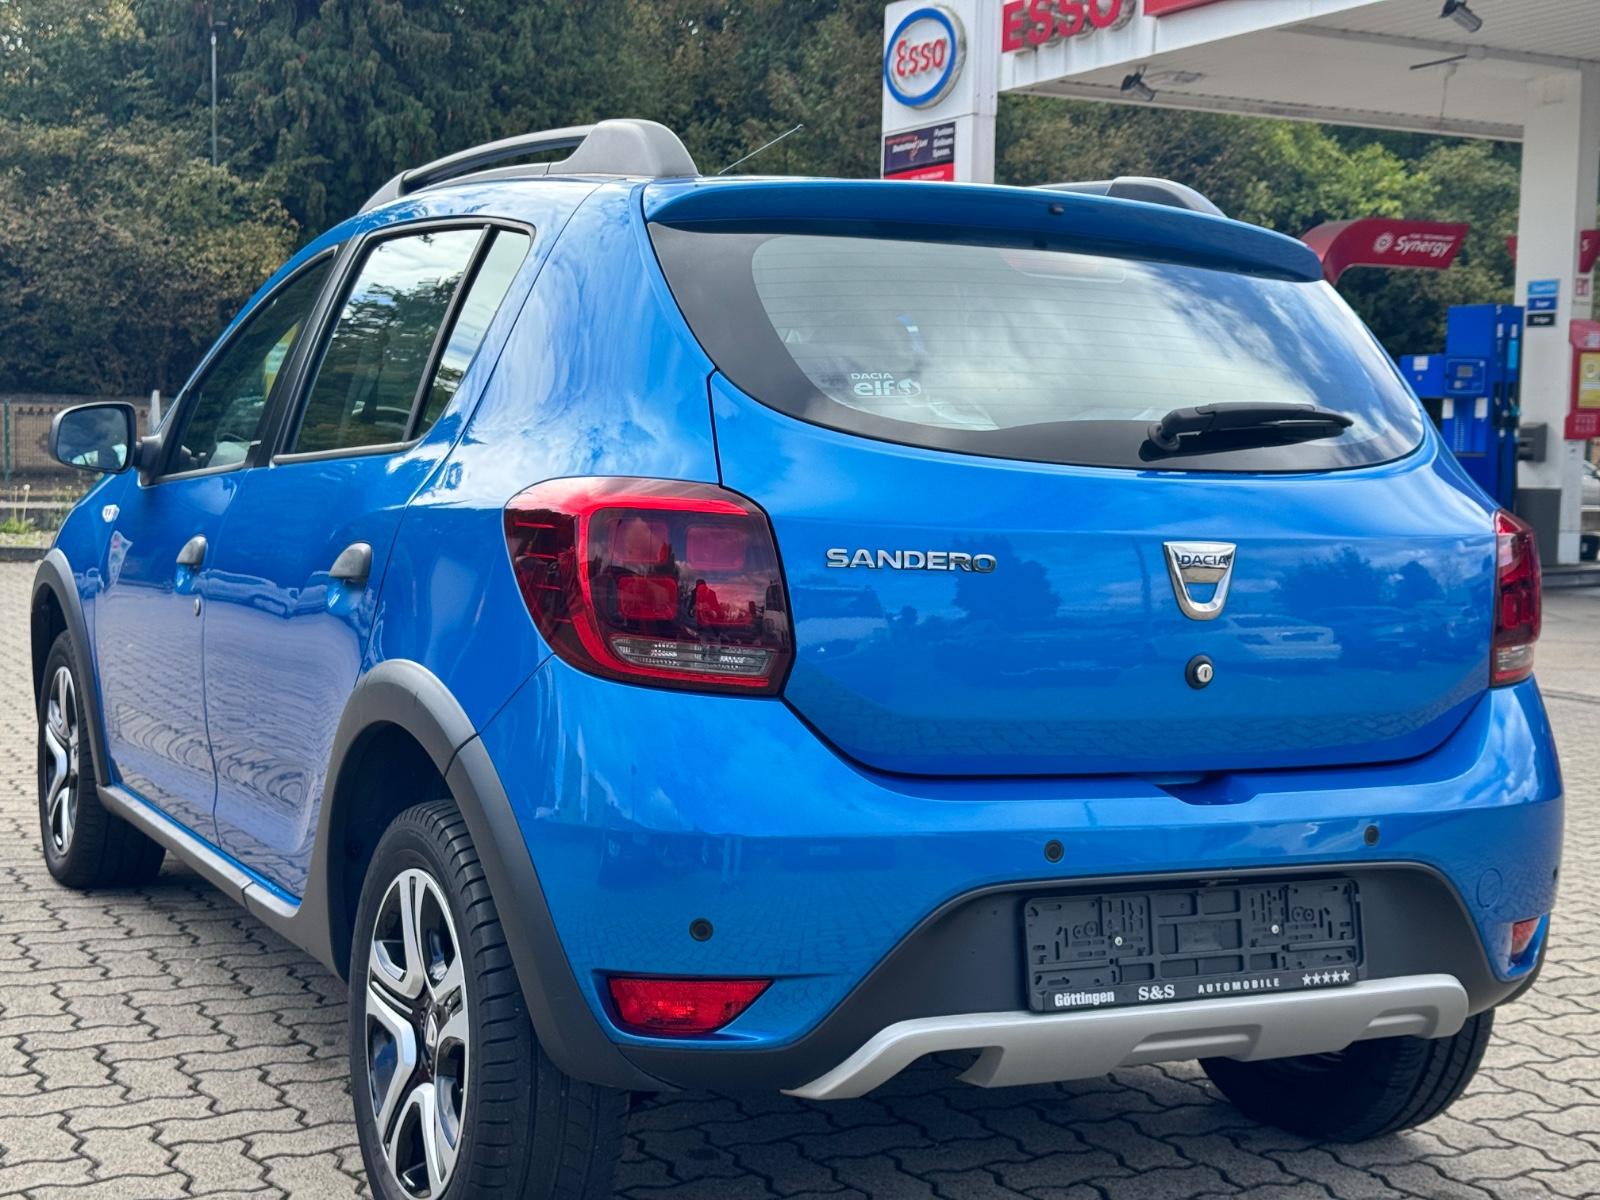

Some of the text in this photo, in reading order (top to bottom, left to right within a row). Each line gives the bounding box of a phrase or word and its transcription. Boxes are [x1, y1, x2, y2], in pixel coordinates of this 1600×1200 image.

[1394, 235, 1453, 257] Synergy
[854, 381, 895, 396] elf
[826, 548, 996, 573] SANDERO
[1181, 555, 1227, 566] DACIA
[1054, 978, 1280, 1007] Göttingen S&S AUTOMOBILE
